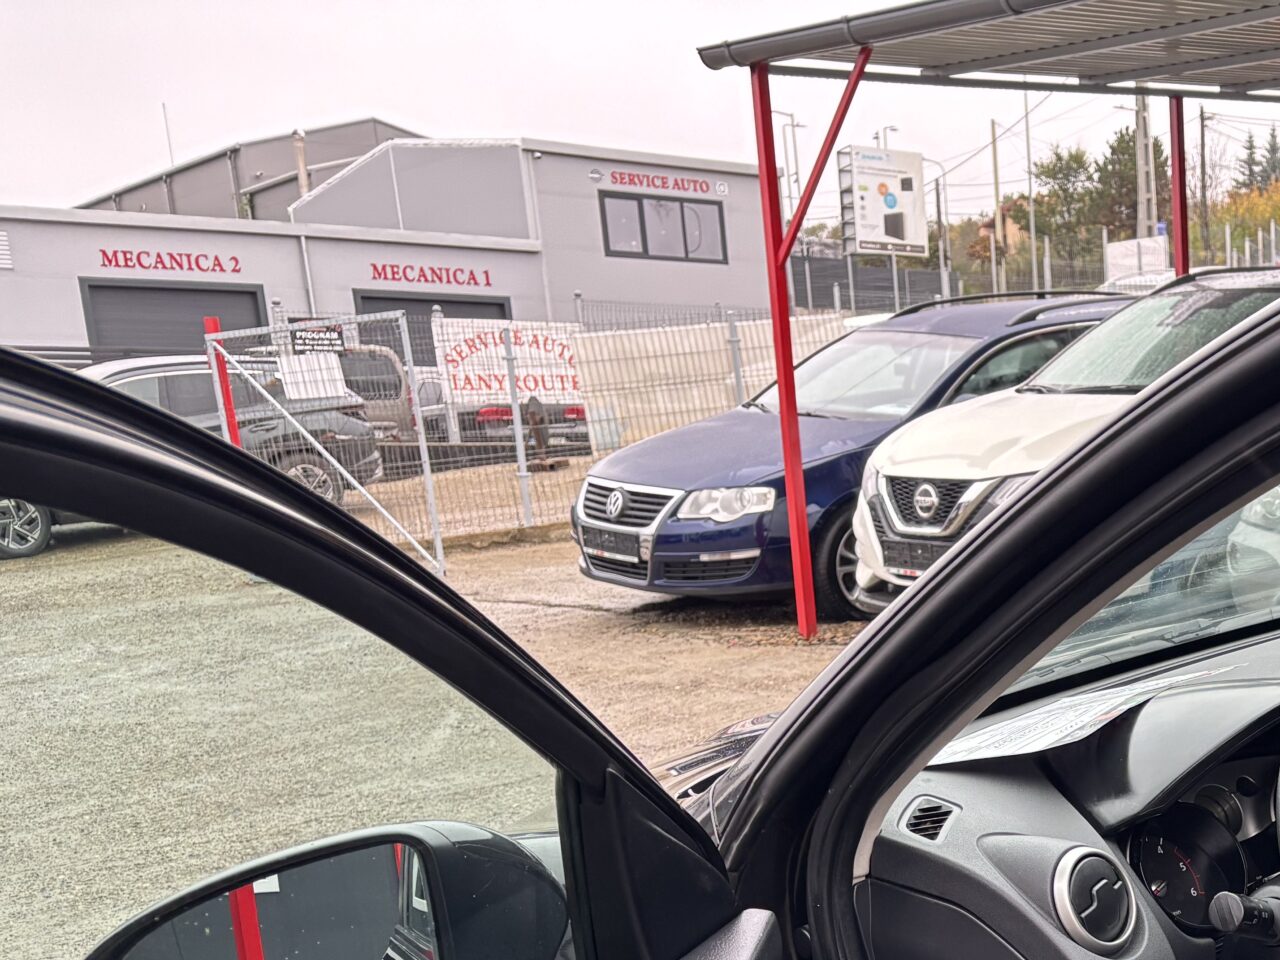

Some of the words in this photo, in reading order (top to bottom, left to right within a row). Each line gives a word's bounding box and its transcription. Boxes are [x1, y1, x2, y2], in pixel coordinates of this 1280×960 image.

[610, 170, 670, 189] SERVICE
[672, 178, 710, 193] AUTO
[99, 249, 227, 273] MECANICA
[229, 256, 242, 273] 2
[370, 263, 480, 286] MECANICA
[482, 270, 492, 287] 1
[1179, 862, 1187, 872] 5
[1190, 887, 1198, 897] 6
